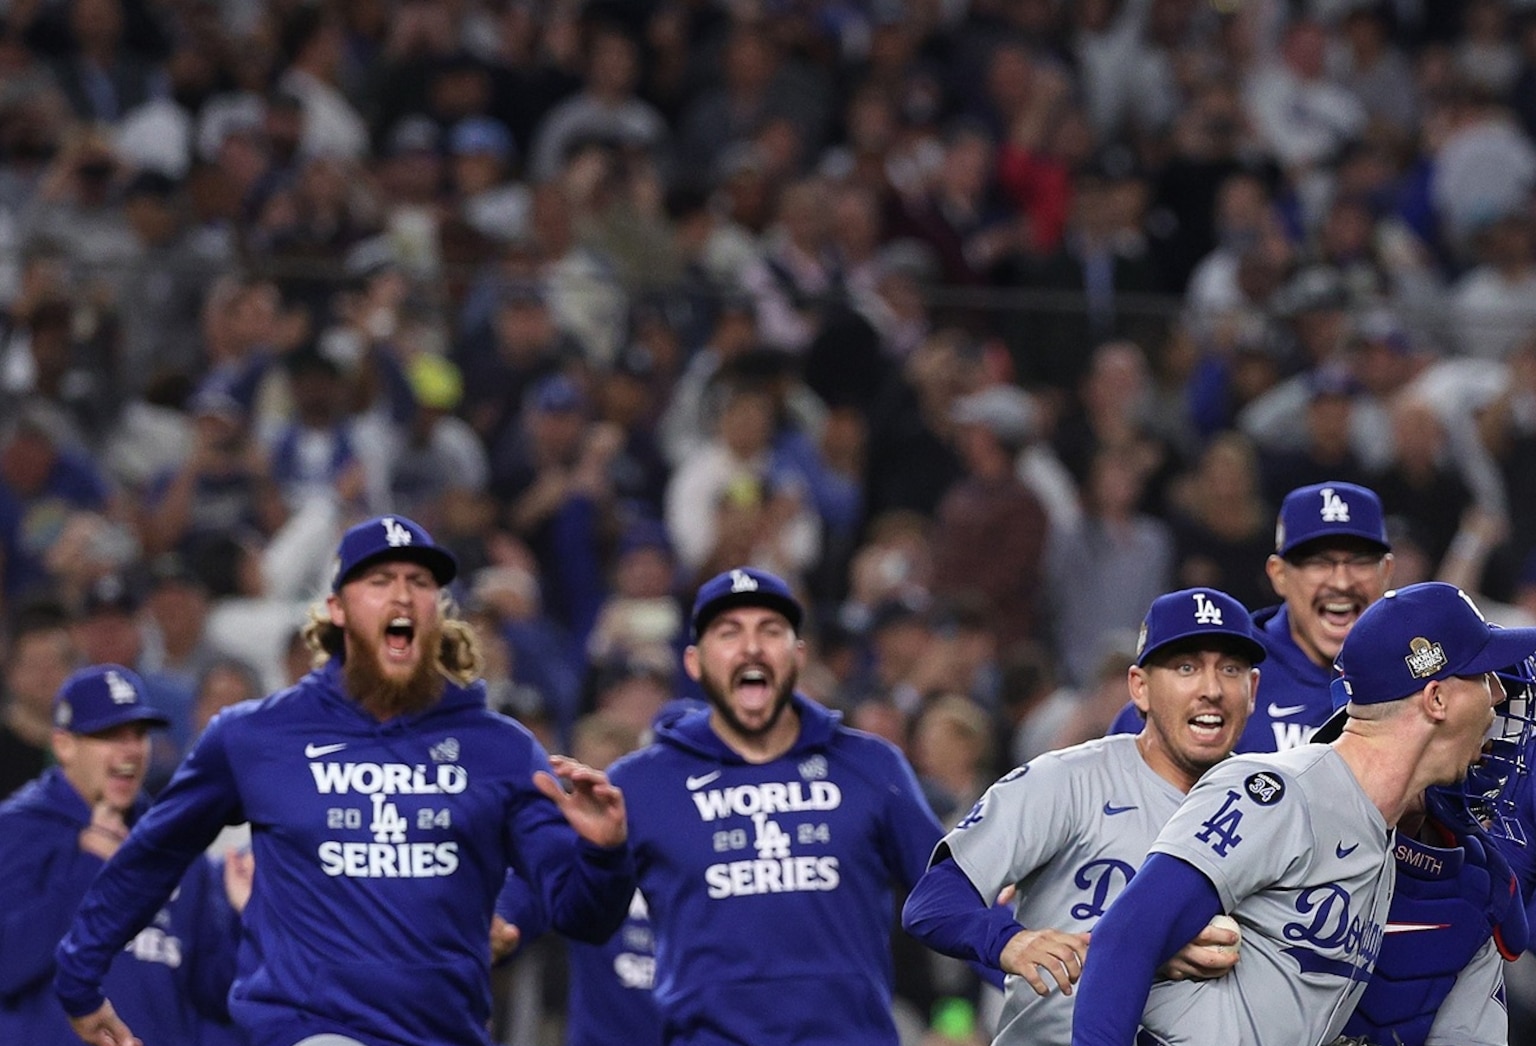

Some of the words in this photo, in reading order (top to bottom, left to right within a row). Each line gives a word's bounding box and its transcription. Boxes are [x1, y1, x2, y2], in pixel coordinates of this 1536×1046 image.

[1320, 488, 1350, 522] LA
[381, 517, 412, 548] LA
[729, 569, 758, 593] LA
[1192, 593, 1223, 625] LA
[309, 762, 469, 795] WORLD
[1248, 778, 1277, 803] 34
[327, 807, 362, 830] 20
[369, 792, 408, 843] LA
[416, 807, 451, 830] 24
[692, 781, 842, 822] WORLD
[750, 811, 791, 859] LA
[1194, 790, 1244, 858] LA
[318, 840, 459, 878] SERIES
[1395, 845, 1443, 875] SMITH
[704, 856, 840, 899] SERIES
